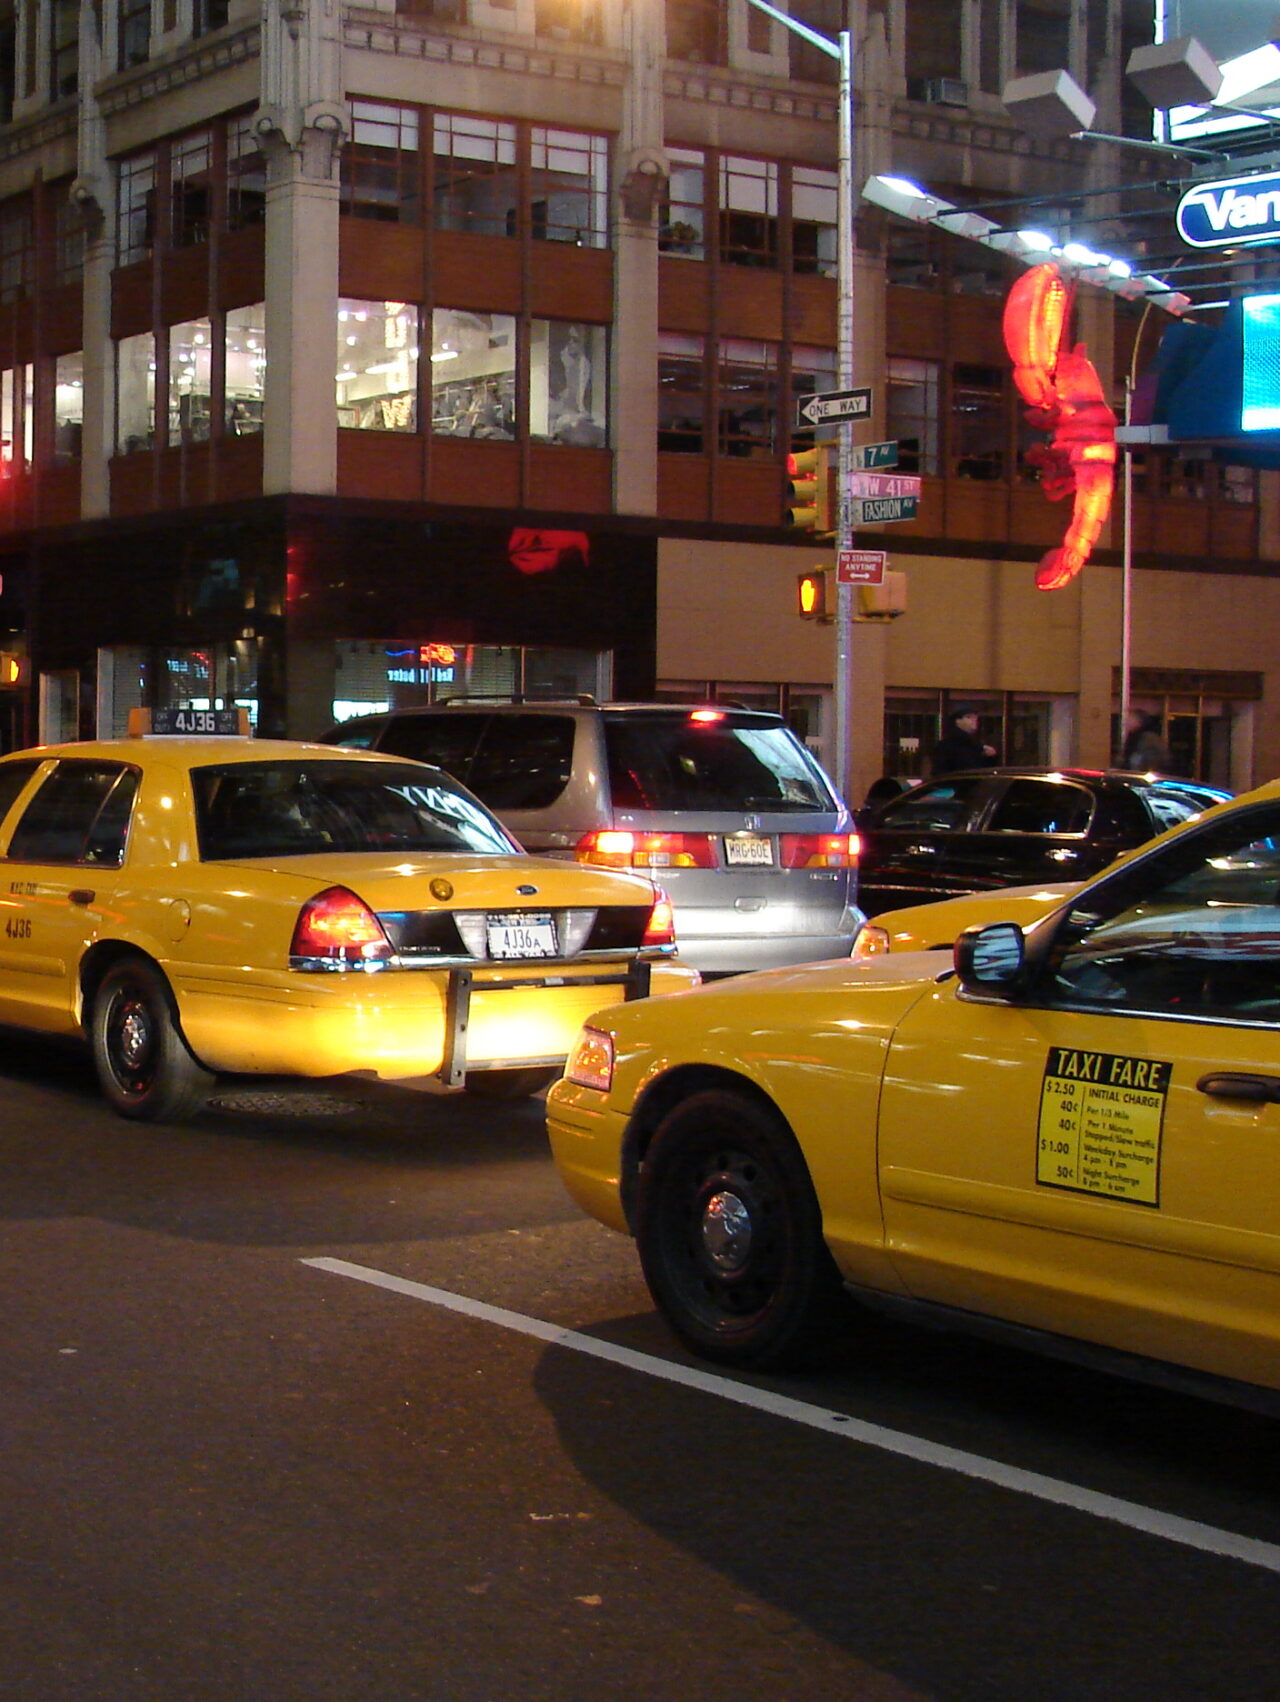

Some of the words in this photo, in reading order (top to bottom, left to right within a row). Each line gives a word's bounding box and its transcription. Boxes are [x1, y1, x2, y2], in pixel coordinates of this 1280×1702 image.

[809, 403, 829, 417] ONE
[840, 399, 861, 412] WAY
[868, 448, 878, 466] 7
[880, 445, 890, 456] AV
[869, 479, 880, 495] W
[886, 480, 901, 496] 41
[904, 480, 914, 490] ST
[865, 500, 901, 520] FASHION
[903, 499, 913, 508] AV
[841, 554, 851, 562] NO
[852, 554, 882, 562] STANDING
[845, 563, 877, 571] ANYTIME
[175, 712, 215, 731] 4J36
[6, 918, 31, 938] 4J36
[1057, 1050, 1103, 1080] TAXI
[1109, 1058, 1162, 1089] FARE
[1089, 1088, 1119, 1101] INITIAL
[1123, 1093, 1160, 1109] CHARGE
[1087, 1105, 1099, 1115] Per
[1114, 1109, 1130, 1120] Mile
[1088, 1119, 1099, 1129] Per
[1109, 1123, 1134, 1135] Minute
